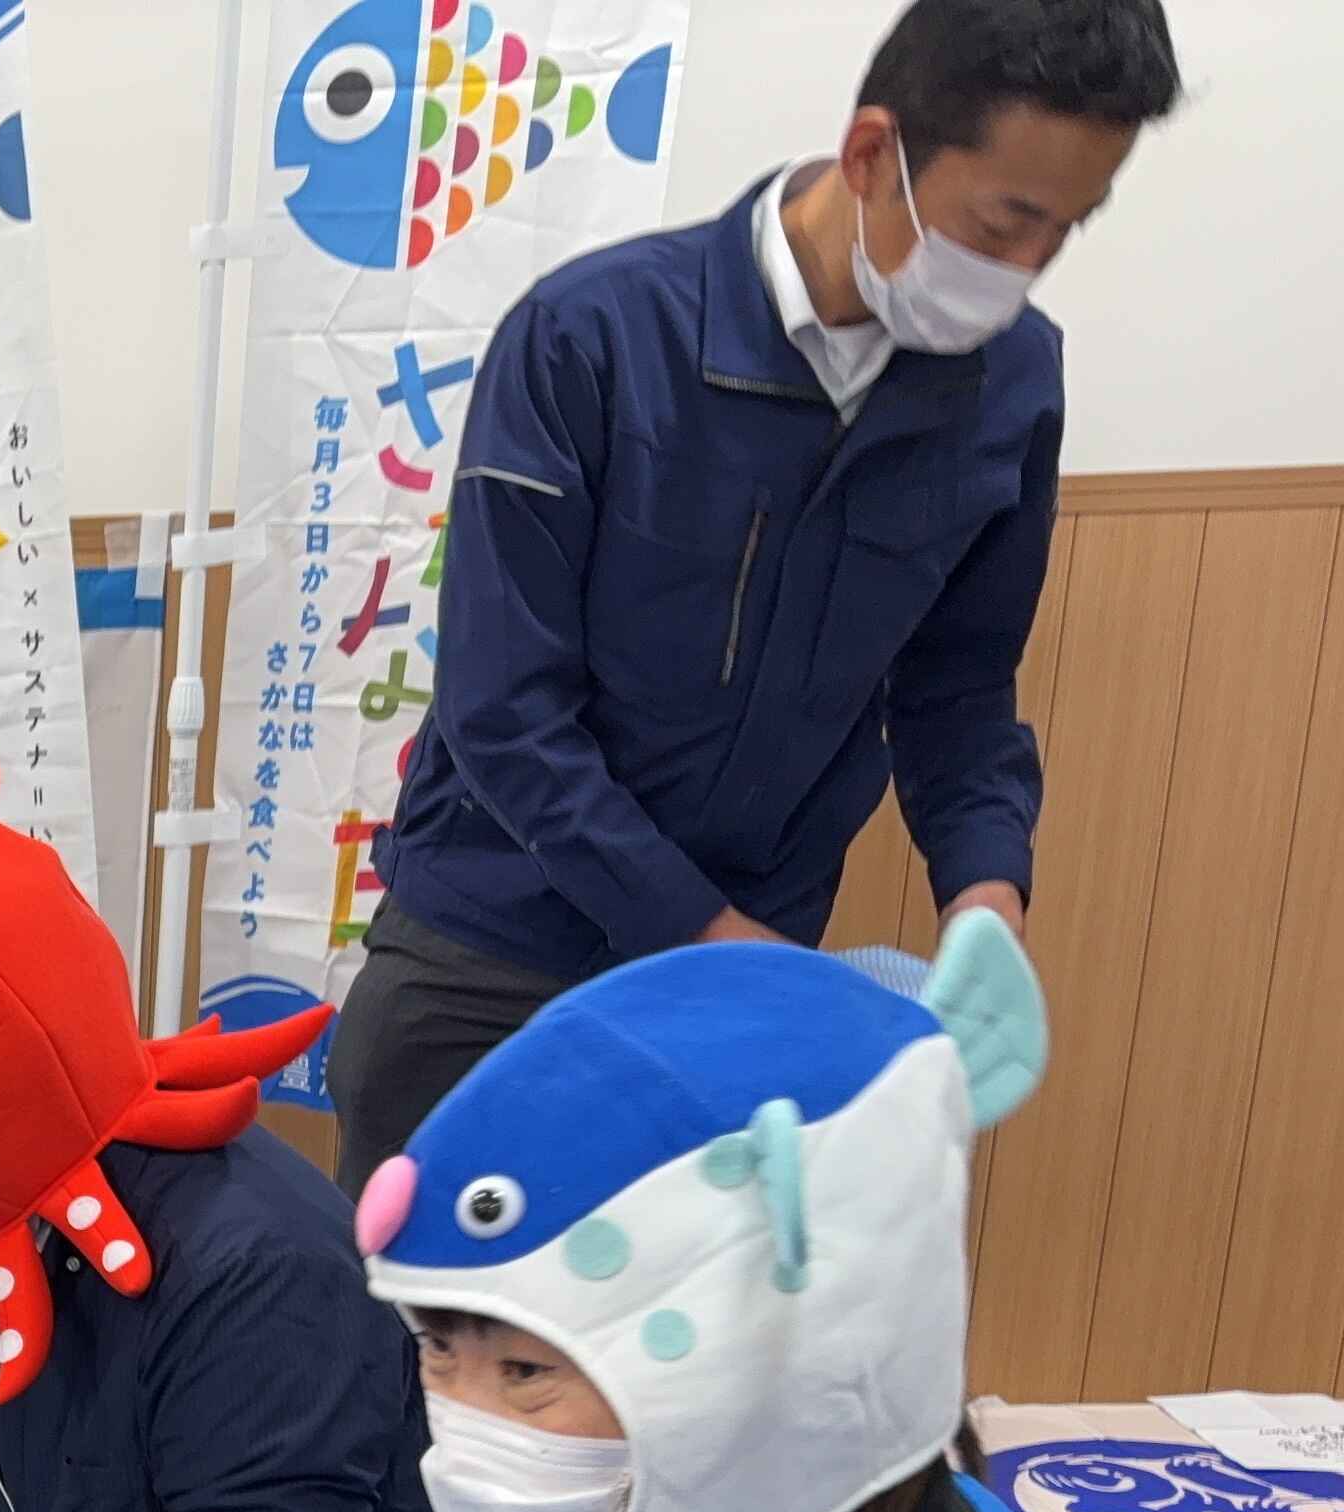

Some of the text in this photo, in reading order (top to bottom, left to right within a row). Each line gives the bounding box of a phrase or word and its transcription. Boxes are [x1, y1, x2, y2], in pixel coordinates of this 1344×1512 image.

[289, 395, 348, 751] 毎月3日から7日は
[240, 640, 288, 939] さかなを食べよう
